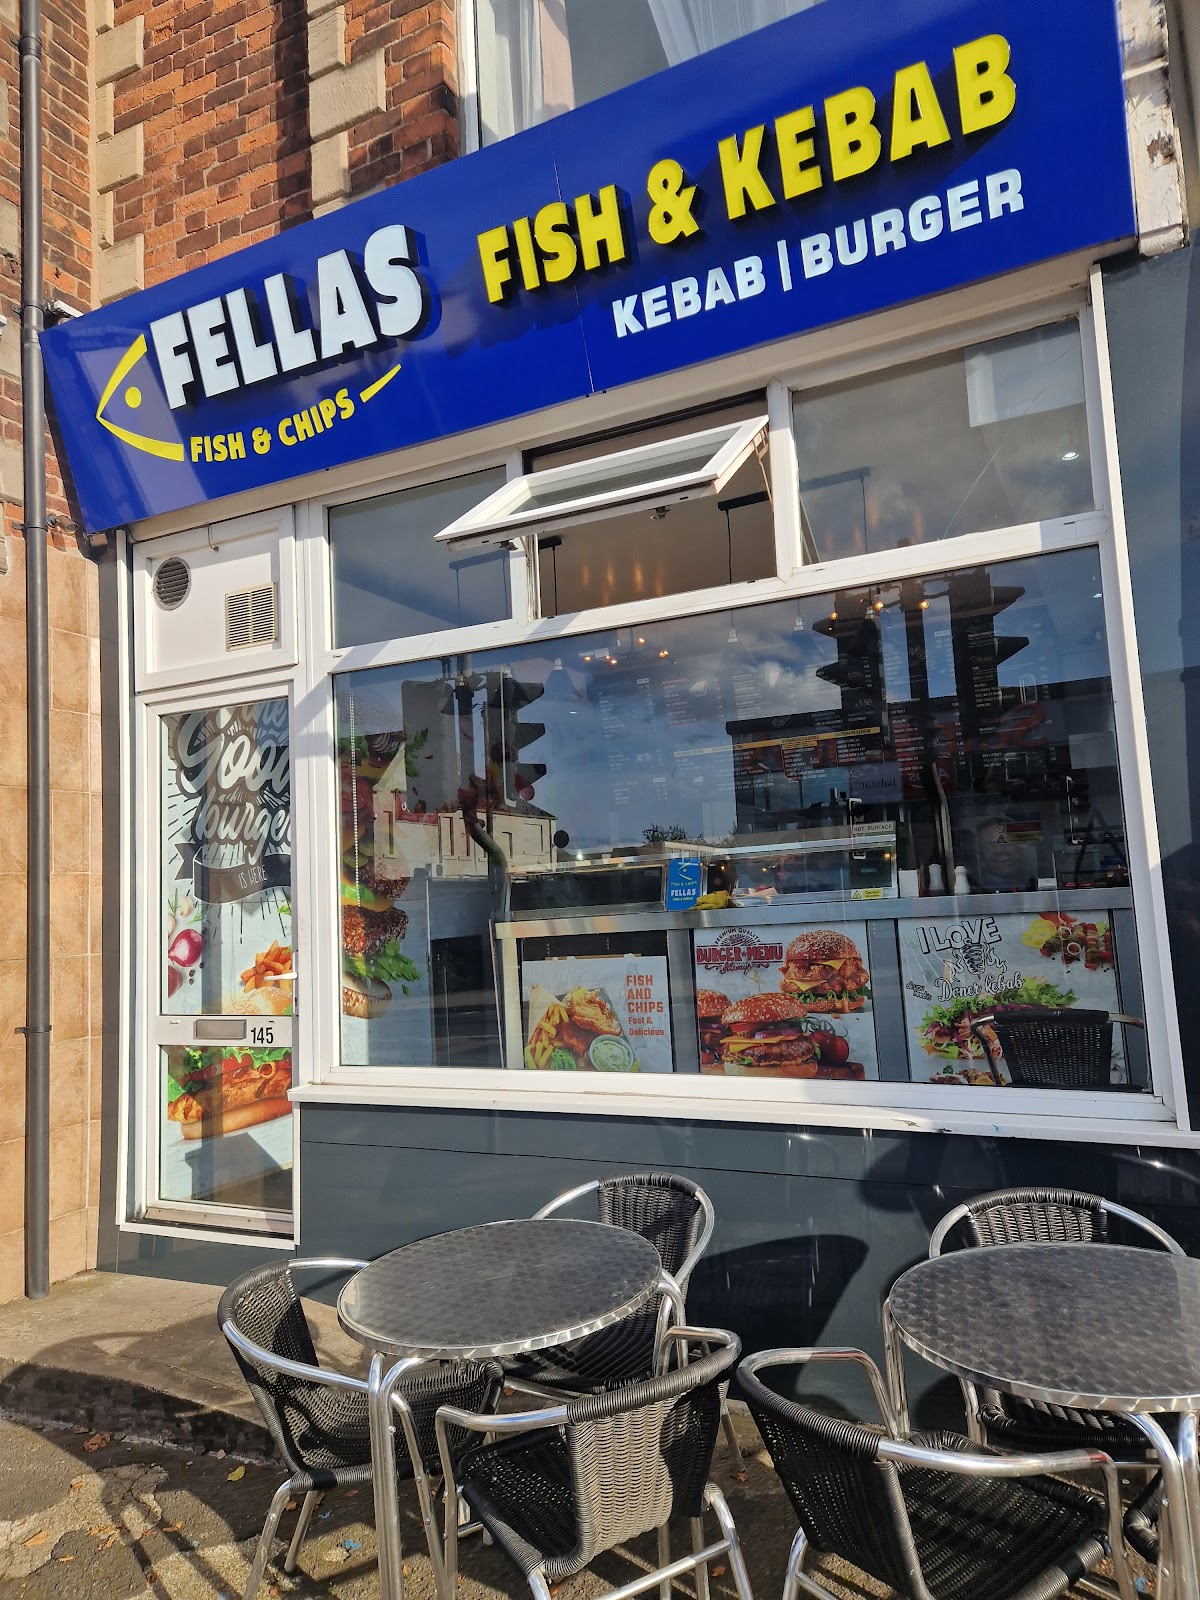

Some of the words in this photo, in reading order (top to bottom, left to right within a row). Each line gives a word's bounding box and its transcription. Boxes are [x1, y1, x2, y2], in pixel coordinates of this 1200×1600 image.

[478, 186, 625, 304] FISH
[647, 159, 700, 246] &
[718, 34, 1017, 221] KEBAB
[611, 255, 766, 339] KEBAB
[800, 168, 1025, 280] BURGER
[150, 225, 424, 410] FELLAS
[190, 433, 245, 462] FISH
[252, 427, 271, 455] &
[279, 389, 354, 446] CHIPS
[196, 787, 290, 866] burge
[867, 823, 892, 831] SURFACE
[238, 871, 248, 890] IS
[249, 864, 268, 885] HERE
[670, 888, 697, 897] FELLAS
[715, 927, 737, 945] PREMIUM
[738, 927, 762, 943] QUALITY
[915, 926, 931, 955] I
[929, 917, 1003, 952] LOVE
[696, 946, 743, 963] BURGER
[746, 945, 784, 961] MENU
[626, 975, 653, 987] FISH
[935, 977, 982, 1002] Doner
[627, 988, 651, 1000] AND
[627, 1001, 664, 1013] CHIPS
[628, 1016, 645, 1025] Fast
[646, 1017, 653, 1025] &
[250, 1027, 274, 1044] 145
[629, 1028, 665, 1036] Delicious
